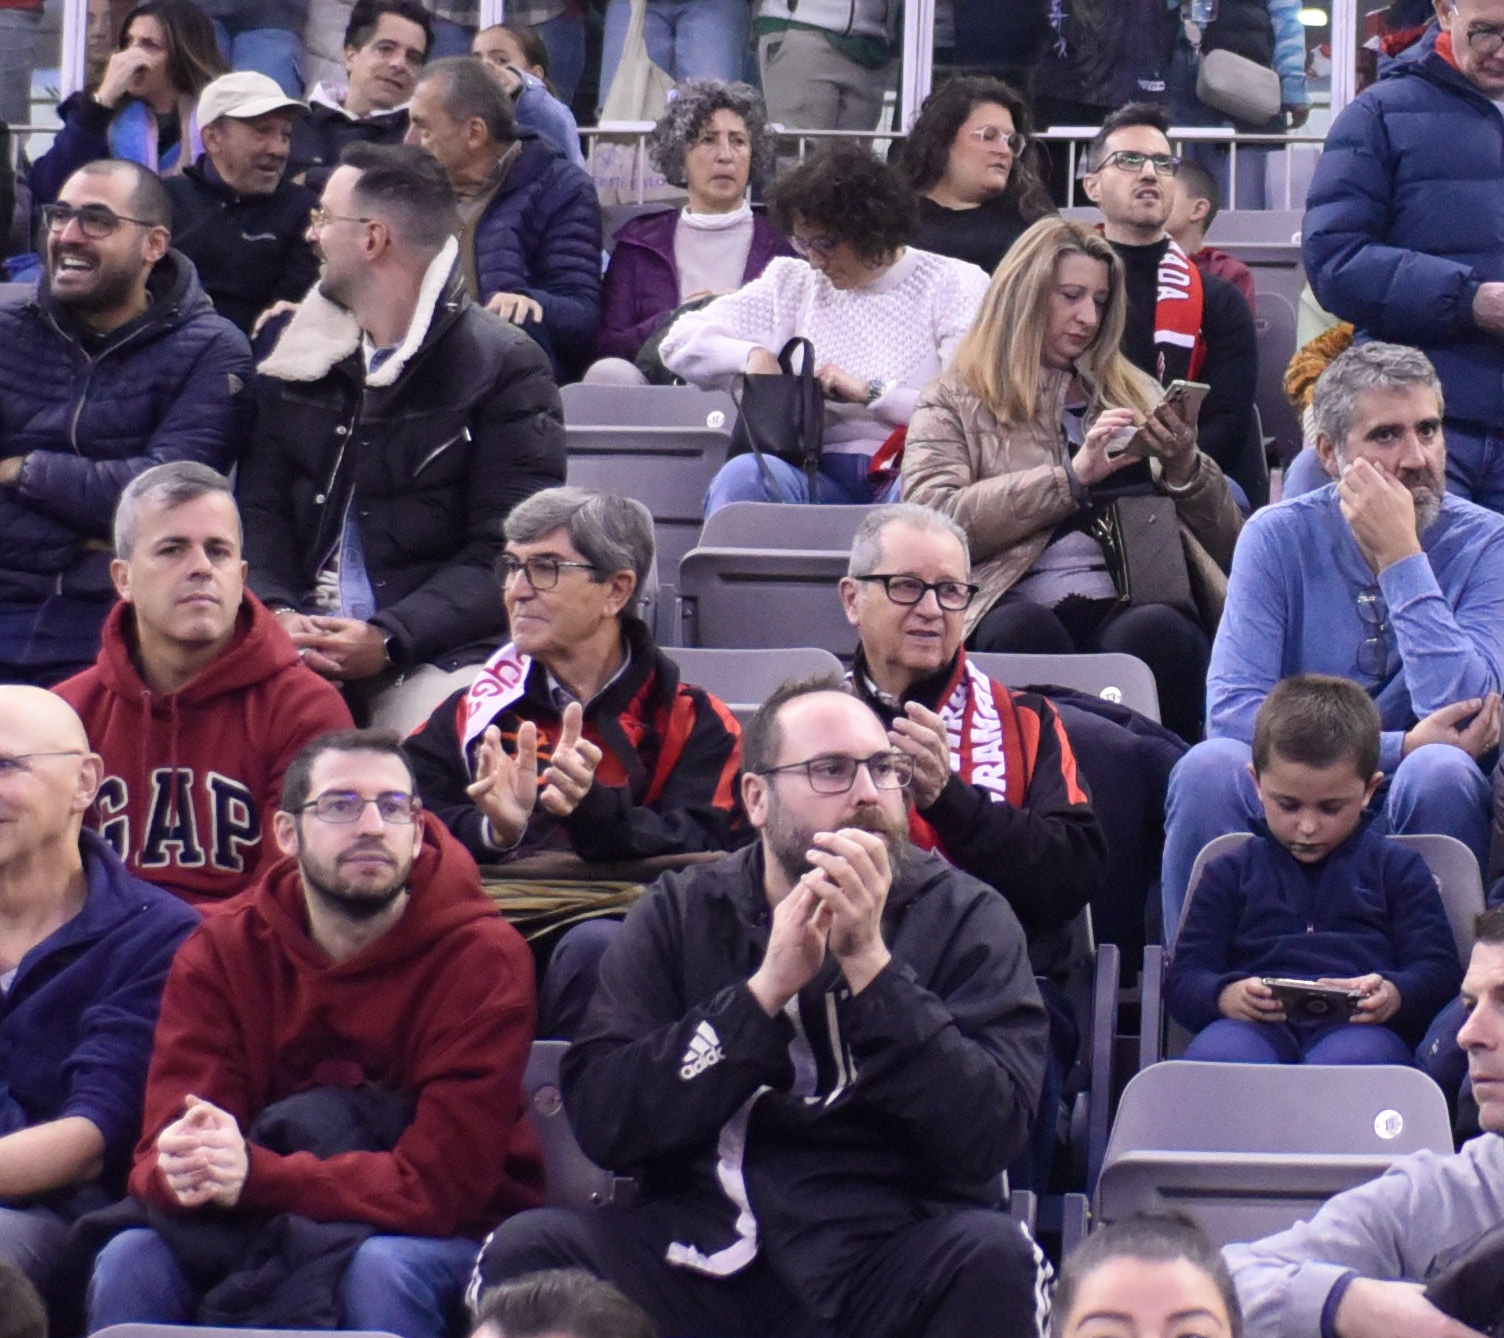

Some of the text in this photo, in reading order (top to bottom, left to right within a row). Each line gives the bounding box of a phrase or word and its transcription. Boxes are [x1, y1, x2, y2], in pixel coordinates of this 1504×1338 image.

[970, 659, 1007, 803] RANA
[98, 767, 263, 874] GAP
[680, 1046, 727, 1080] adid
